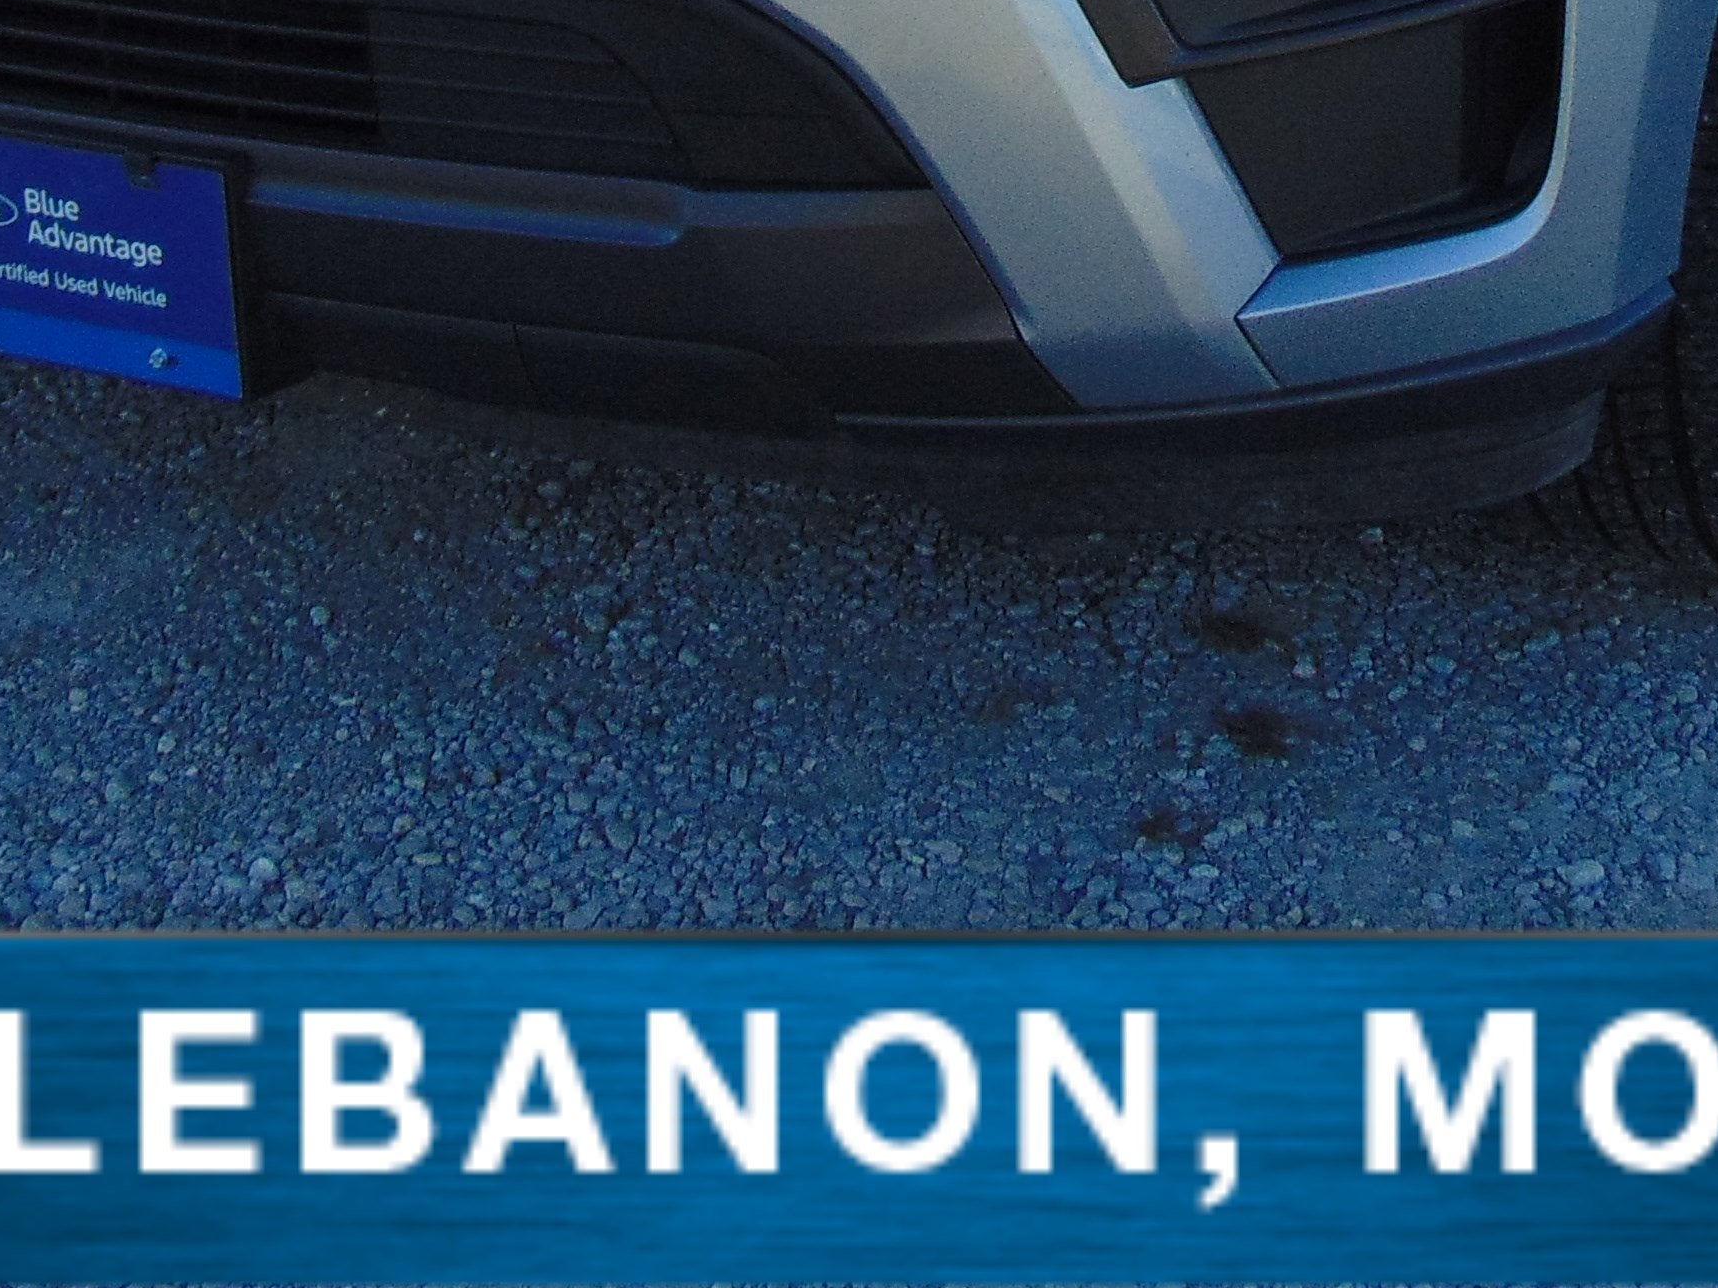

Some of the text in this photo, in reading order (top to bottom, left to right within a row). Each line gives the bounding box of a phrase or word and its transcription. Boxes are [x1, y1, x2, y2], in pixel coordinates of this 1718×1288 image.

[24, 188, 80, 221] Blue
[27, 219, 163, 268] Advantage
[54, 271, 99, 297] Used
[102, 279, 168, 309] Vehicle
